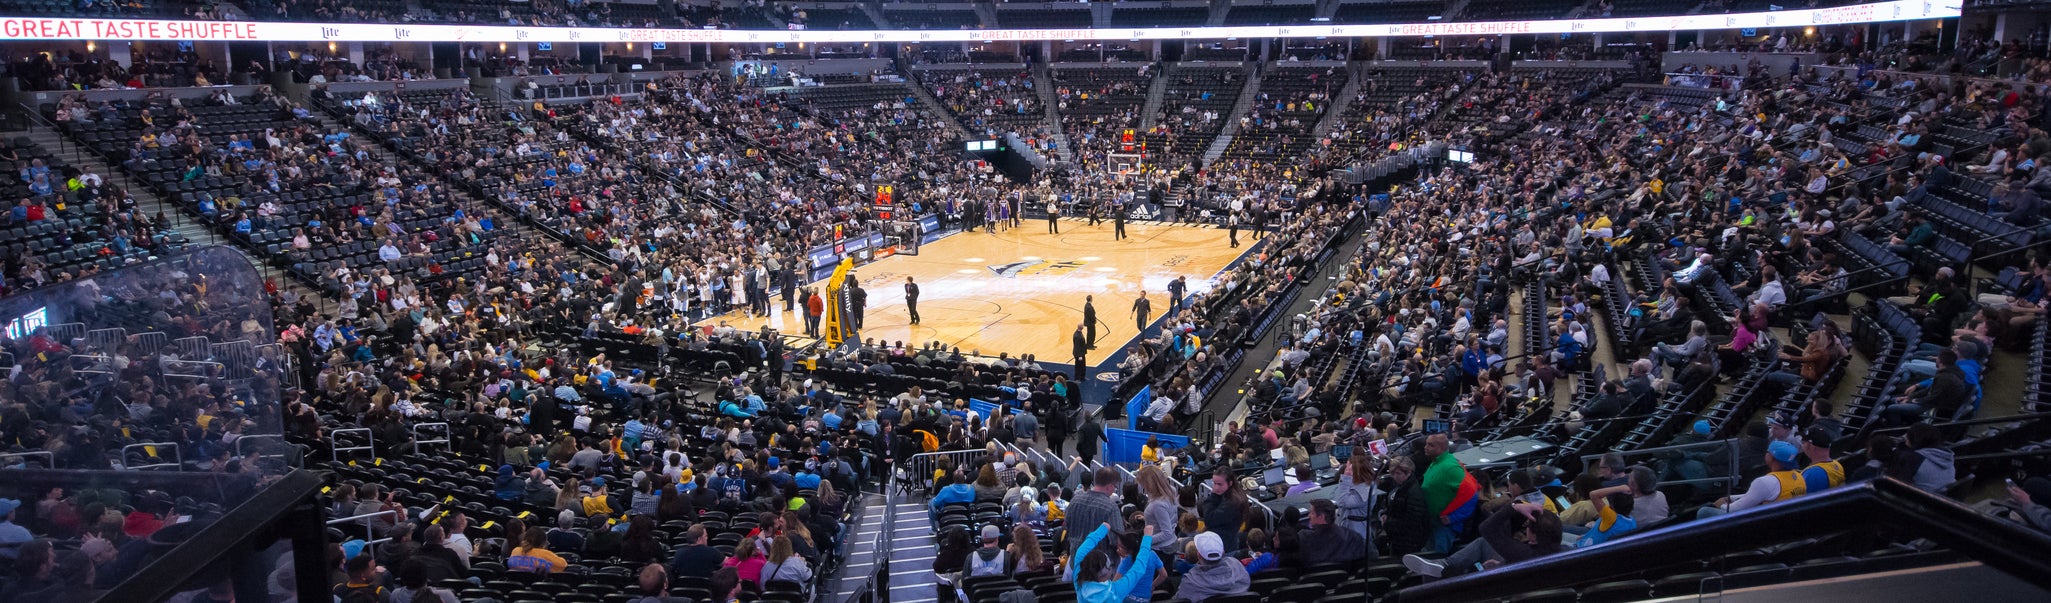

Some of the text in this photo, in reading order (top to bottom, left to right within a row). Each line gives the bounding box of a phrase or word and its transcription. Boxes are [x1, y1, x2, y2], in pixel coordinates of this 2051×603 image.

[4, 19, 258, 39] GREAT TASTE SHUFFLE
[322, 26, 339, 39] Lite
[395, 27, 410, 39] Lite
[1402, 22, 1530, 34] GREAT TASTE SHUFFLE
[516, 30, 528, 41] Lite
[569, 30, 581, 41] Lite
[630, 30, 723, 41] GREAT TASTE SHUFFLE
[982, 30, 1096, 40] GREAT TASTE SHUFFLE
[1129, 212, 1152, 220] adidas
[843, 282, 852, 313] xfinity
